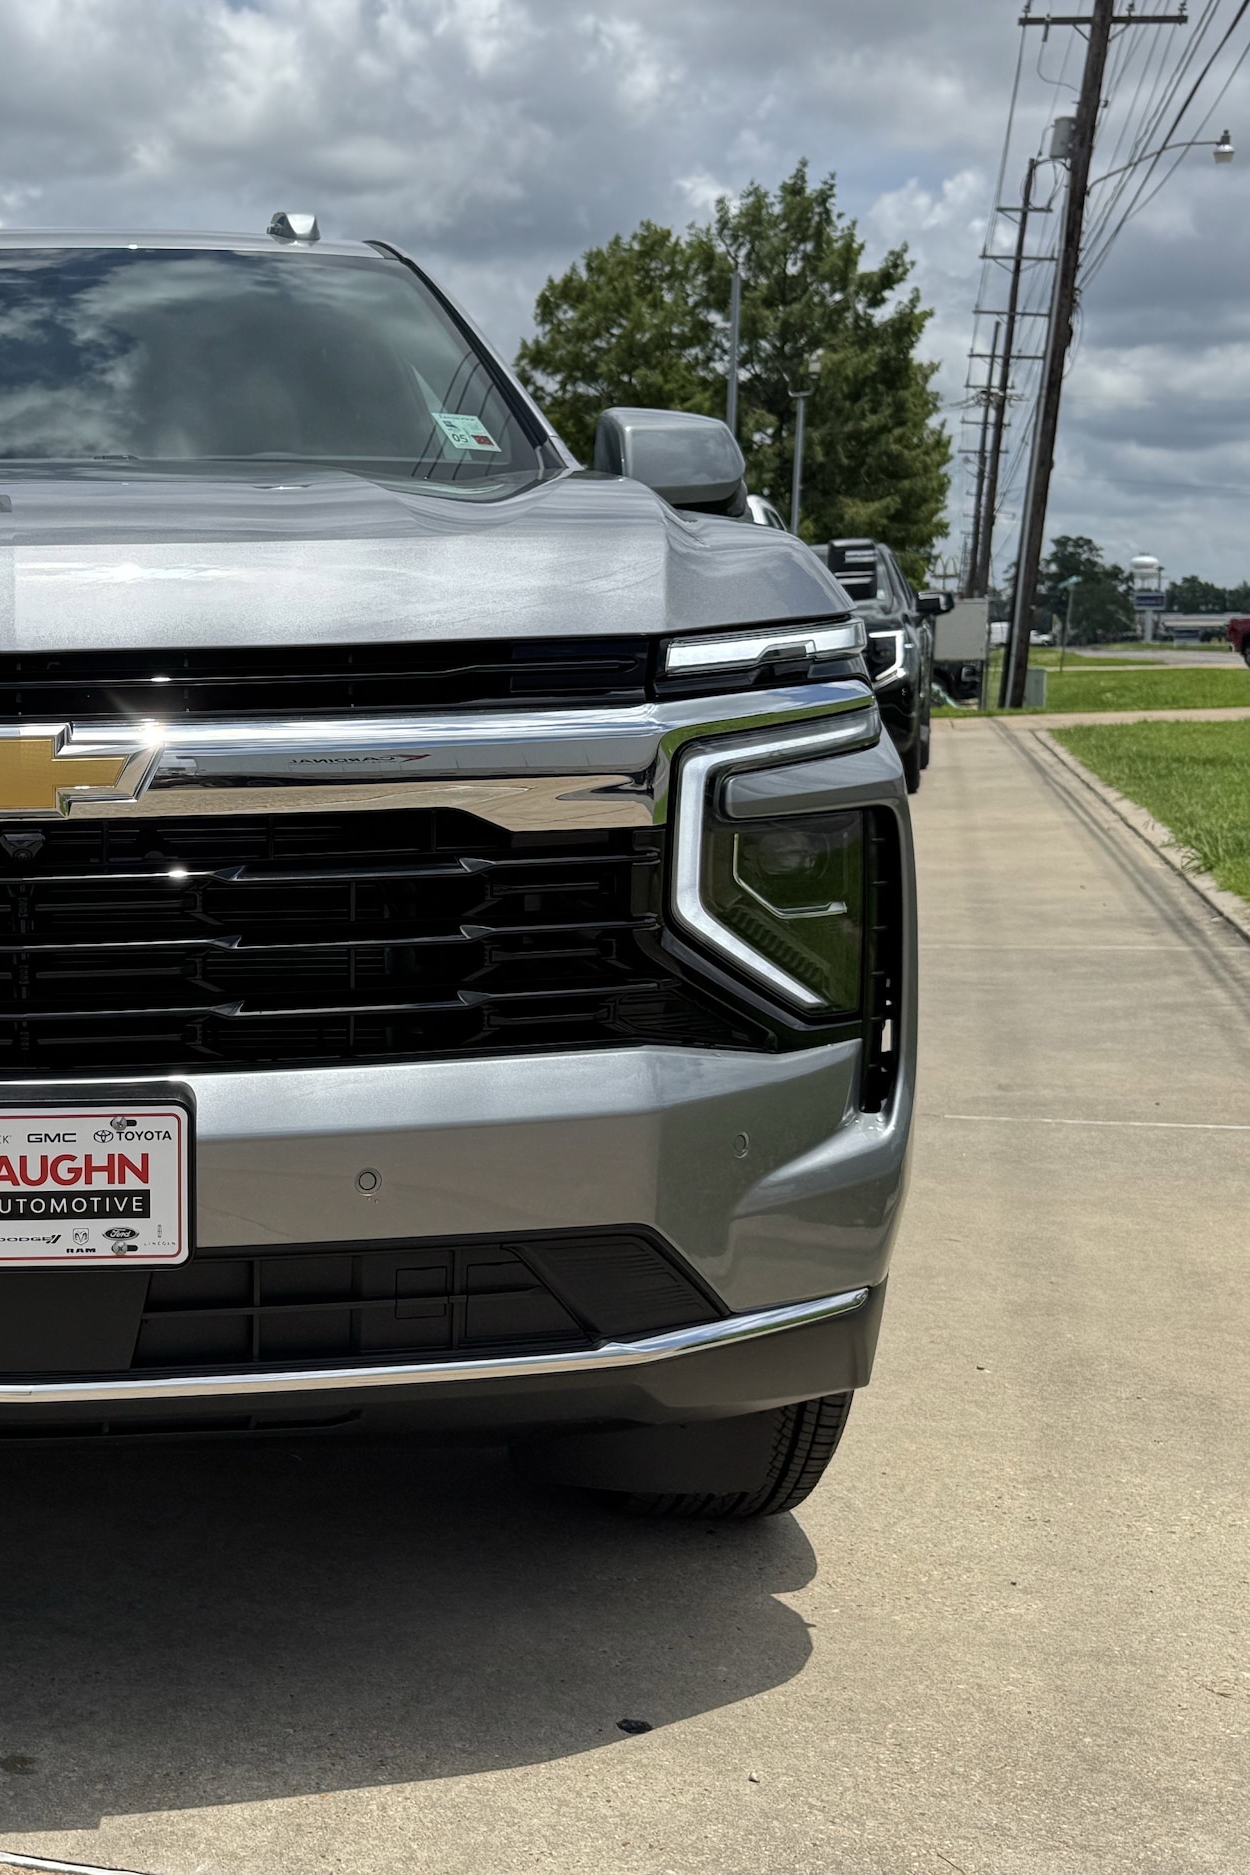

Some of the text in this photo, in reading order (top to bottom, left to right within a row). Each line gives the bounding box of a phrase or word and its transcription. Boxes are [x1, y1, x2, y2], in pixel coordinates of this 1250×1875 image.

[452, 433, 468, 443] 05
[27, 1132, 77, 1143] GMC
[116, 1130, 172, 1141] TOYOTA
